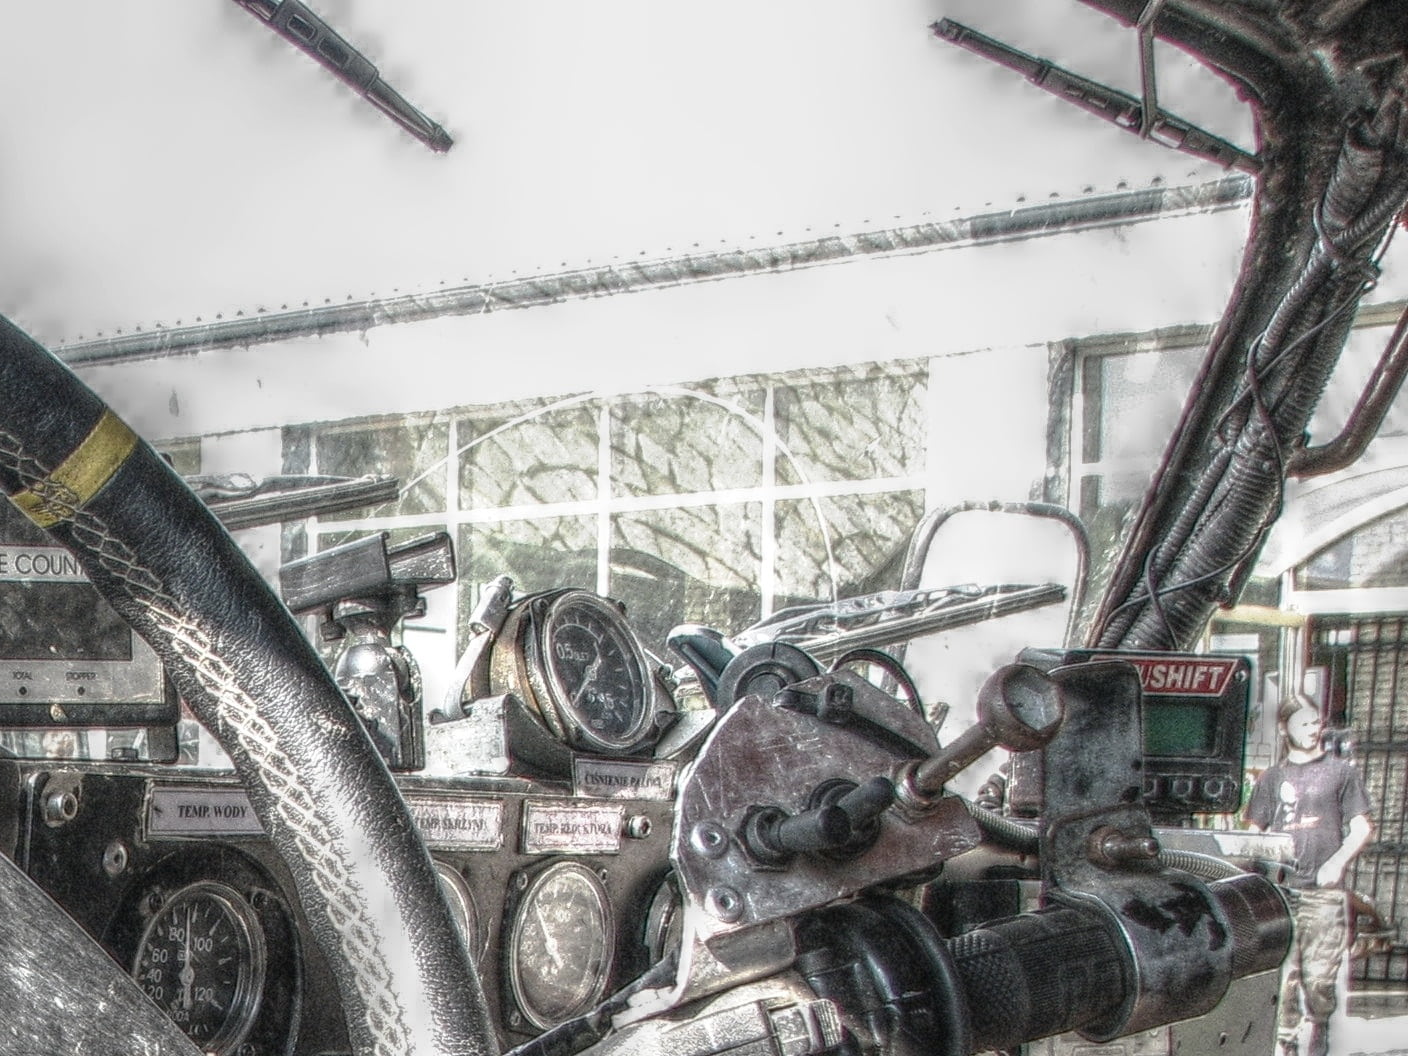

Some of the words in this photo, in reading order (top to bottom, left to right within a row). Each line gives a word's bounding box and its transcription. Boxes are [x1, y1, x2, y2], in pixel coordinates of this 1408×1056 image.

[14, 553, 86, 576] COUN
[12, 672, 33, 680] TOTAL
[178, 805, 211, 818] TEMP.
[213, 805, 248, 818] WODY
[168, 926, 185, 943] 80
[193, 937, 213, 952] 100
[151, 948, 168, 964] 60
[146, 969, 162, 983] 40
[194, 987, 214, 1002] 120
